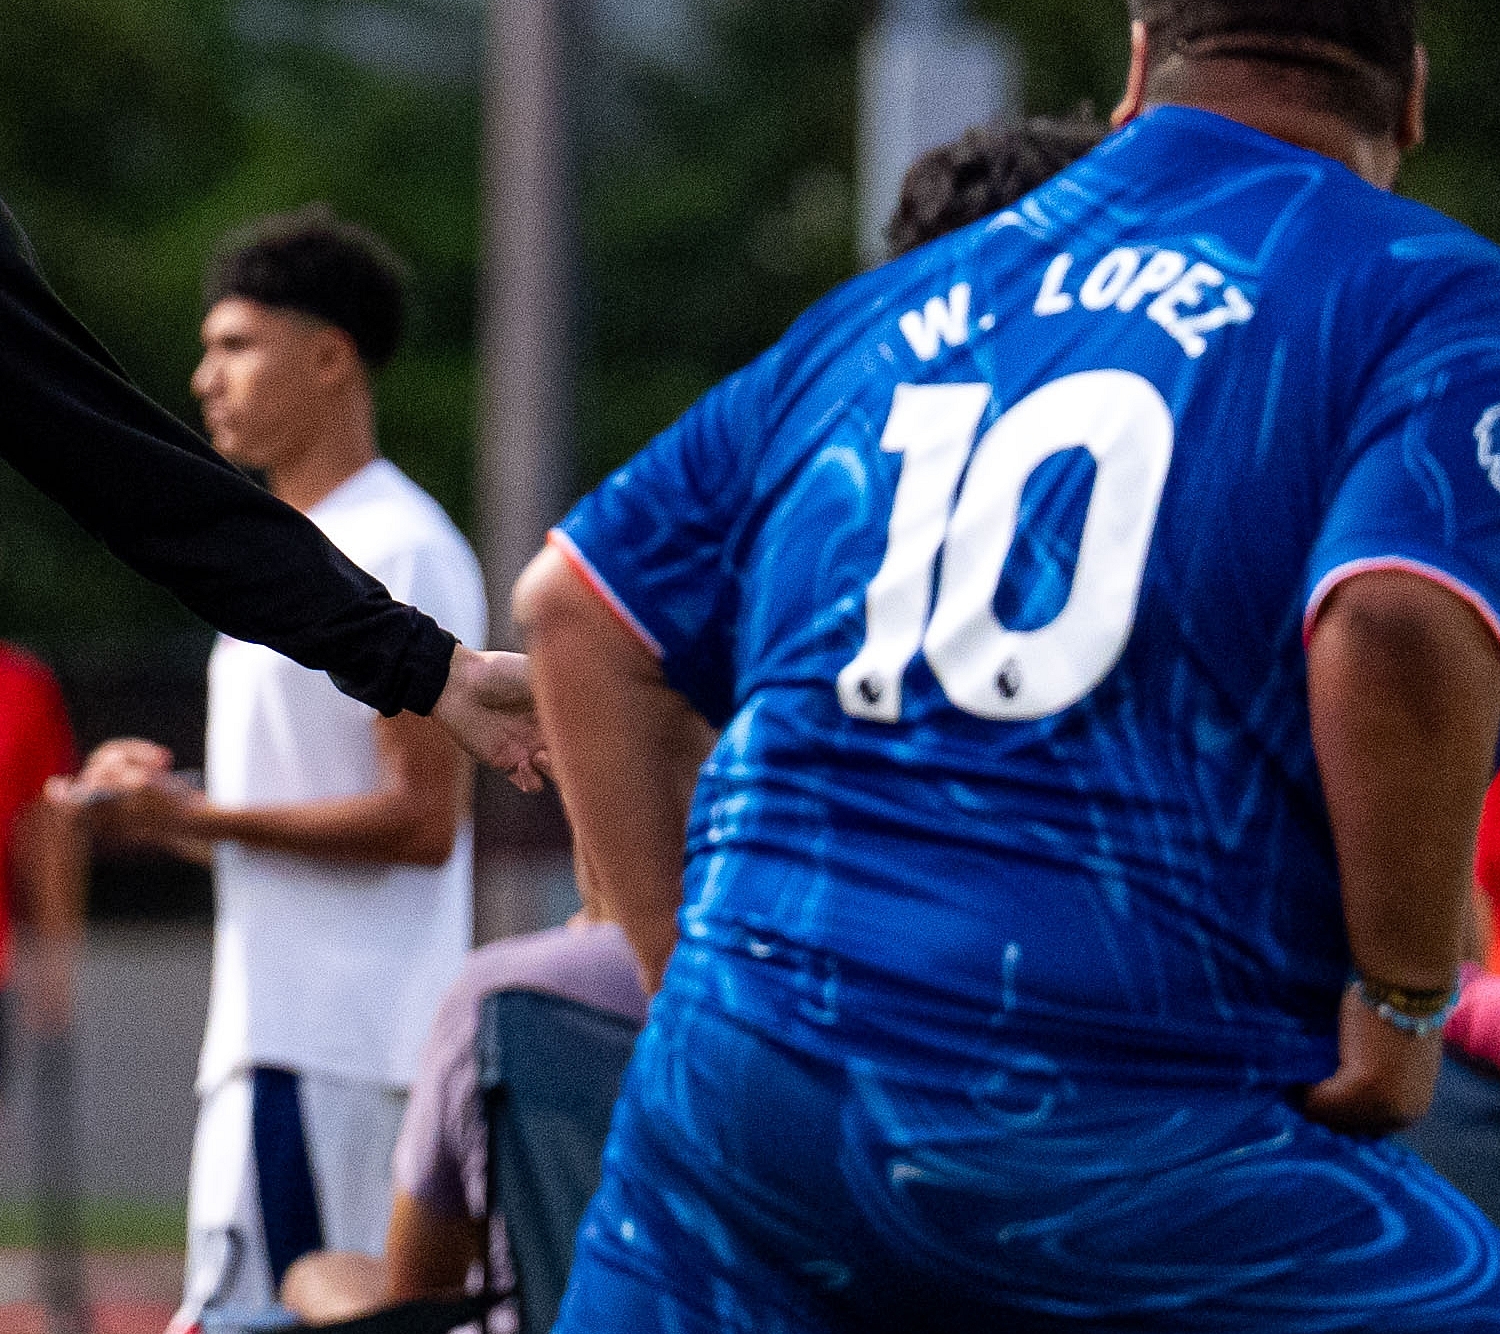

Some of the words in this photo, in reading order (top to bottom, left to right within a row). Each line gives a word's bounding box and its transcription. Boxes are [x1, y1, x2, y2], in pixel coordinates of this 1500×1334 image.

[899, 282, 996, 361] W.
[1032, 245, 1255, 359] LOPEZ
[836, 368, 1174, 724] 10
